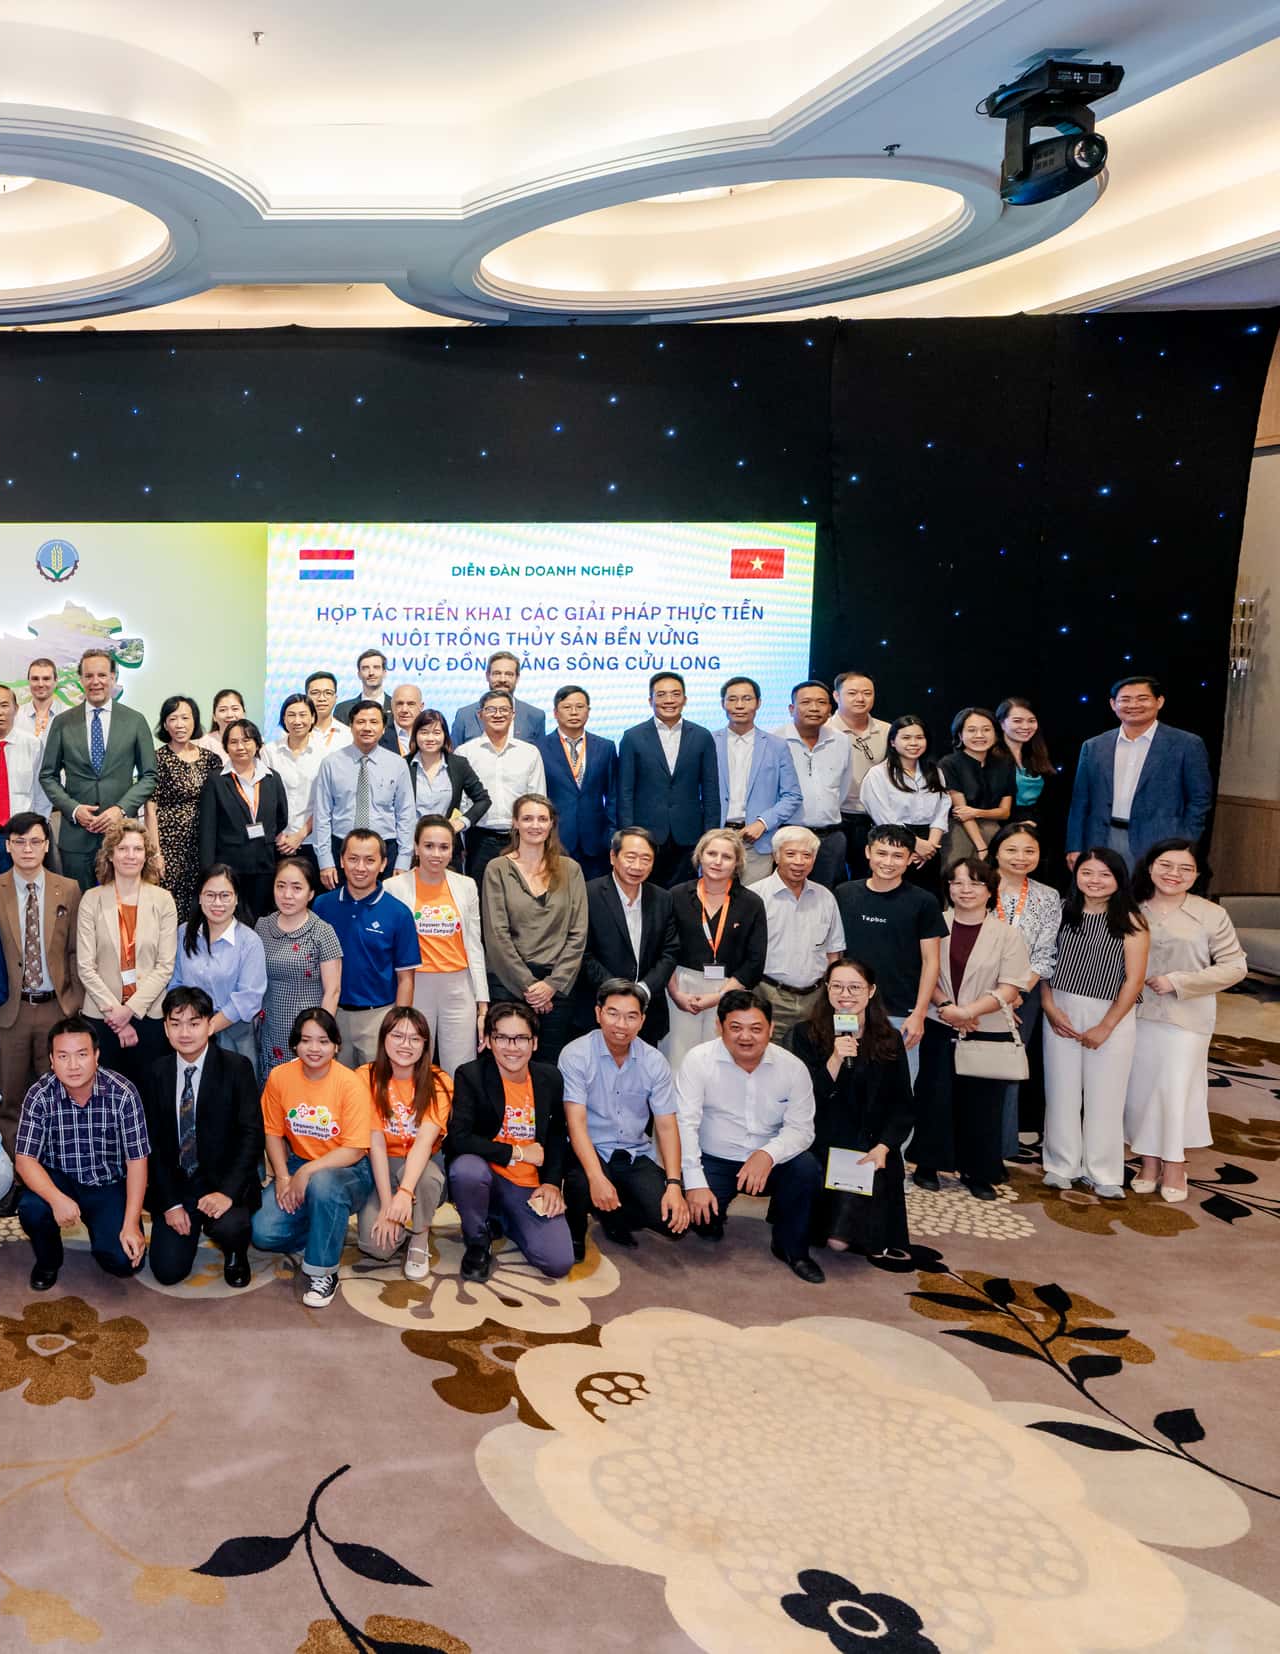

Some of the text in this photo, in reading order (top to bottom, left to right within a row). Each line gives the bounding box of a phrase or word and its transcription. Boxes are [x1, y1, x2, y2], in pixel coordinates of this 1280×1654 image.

[452, 562, 634, 579] DIỄN ĐÀN DOANH NGHIỆP
[317, 598, 764, 626] HỢP TÁC TRIỂN KHAI CÁC GIẢI PHÁP THỰC TIỄN
[382, 627, 430, 647] NUÔI
[435, 625, 500, 647] TRỒNG
[506, 625, 555, 646] THỦY
[560, 626, 598, 646] SẢN
[648, 624, 699, 646] VỮNG
[402, 653, 441, 676] VỰC
[446, 651, 487, 671] ĐỒN
[519, 650, 560, 671] ẰNG
[566, 652, 619, 671] SÔNG
[625, 650, 664, 671] CỬU
[671, 656, 721, 671] LONG
